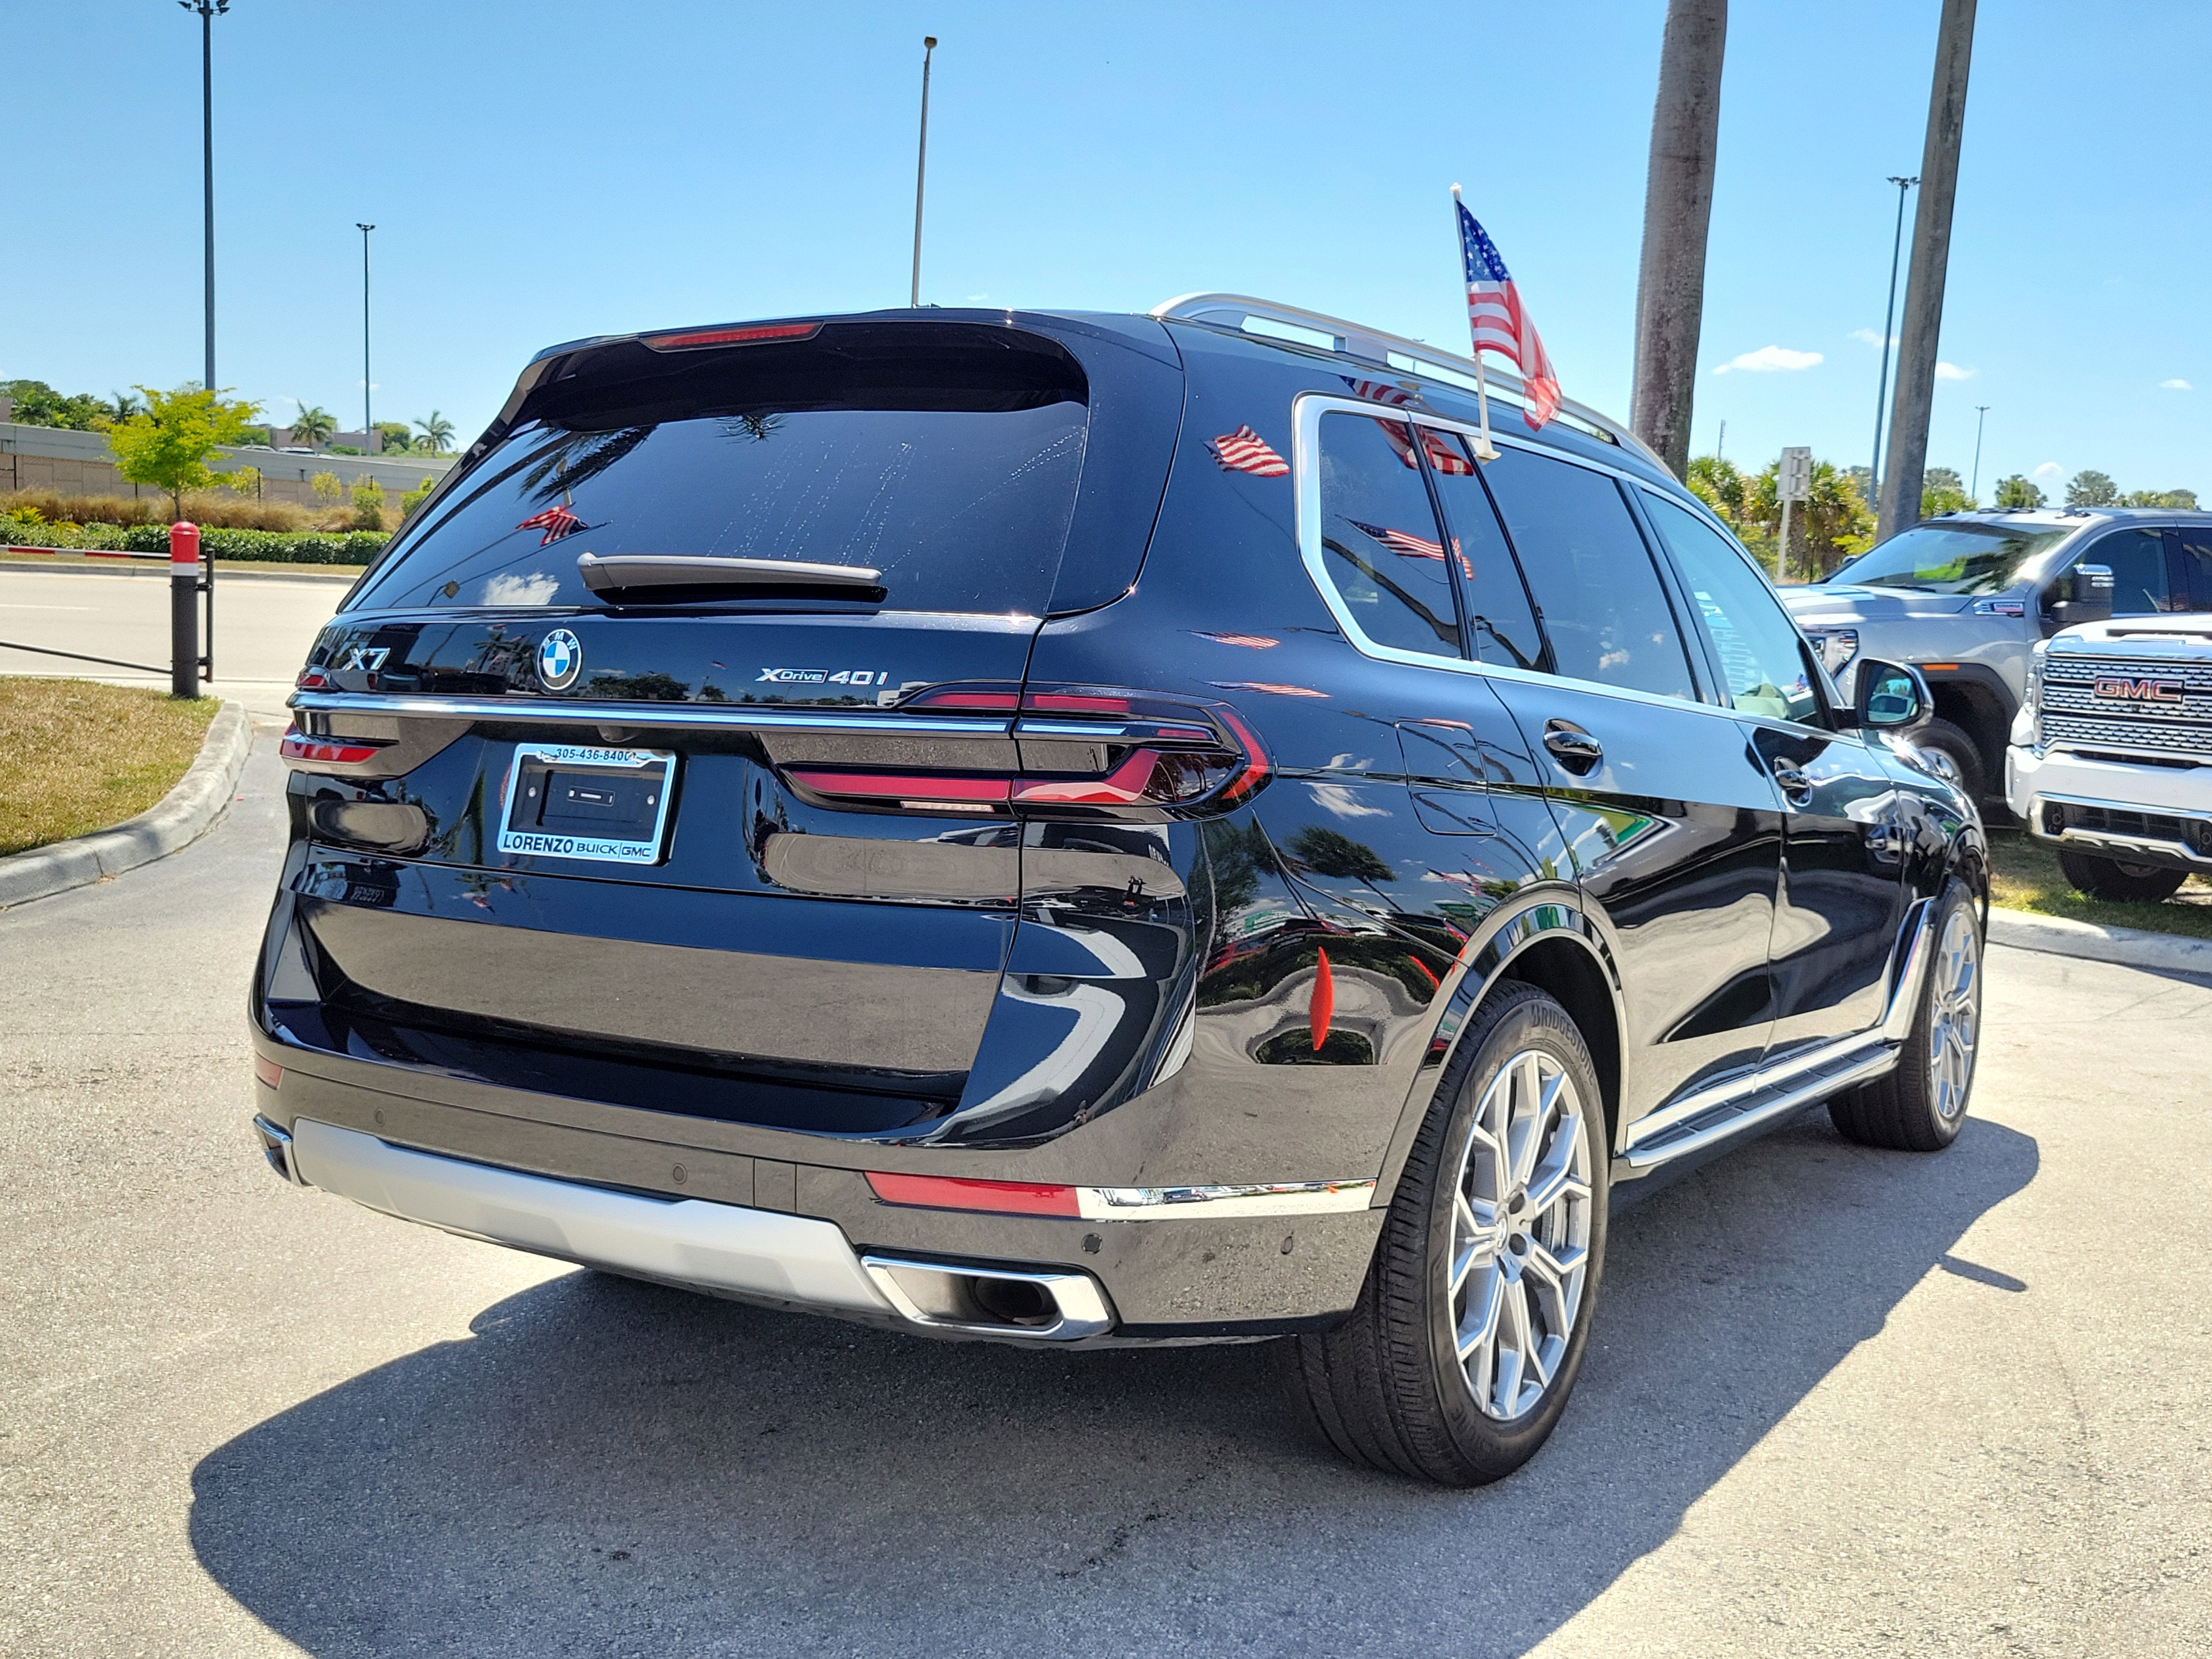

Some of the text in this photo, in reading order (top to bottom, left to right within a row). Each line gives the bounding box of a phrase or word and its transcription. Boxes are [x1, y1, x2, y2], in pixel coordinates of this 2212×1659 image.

[543, 631, 577, 650] BMW
[341, 647, 391, 671] X7
[2094, 677, 2182, 702] GMC
[503, 834, 651, 857] LORENZO BUICK GMC
[1532, 1004, 1594, 1086] BRIDGESTONE
